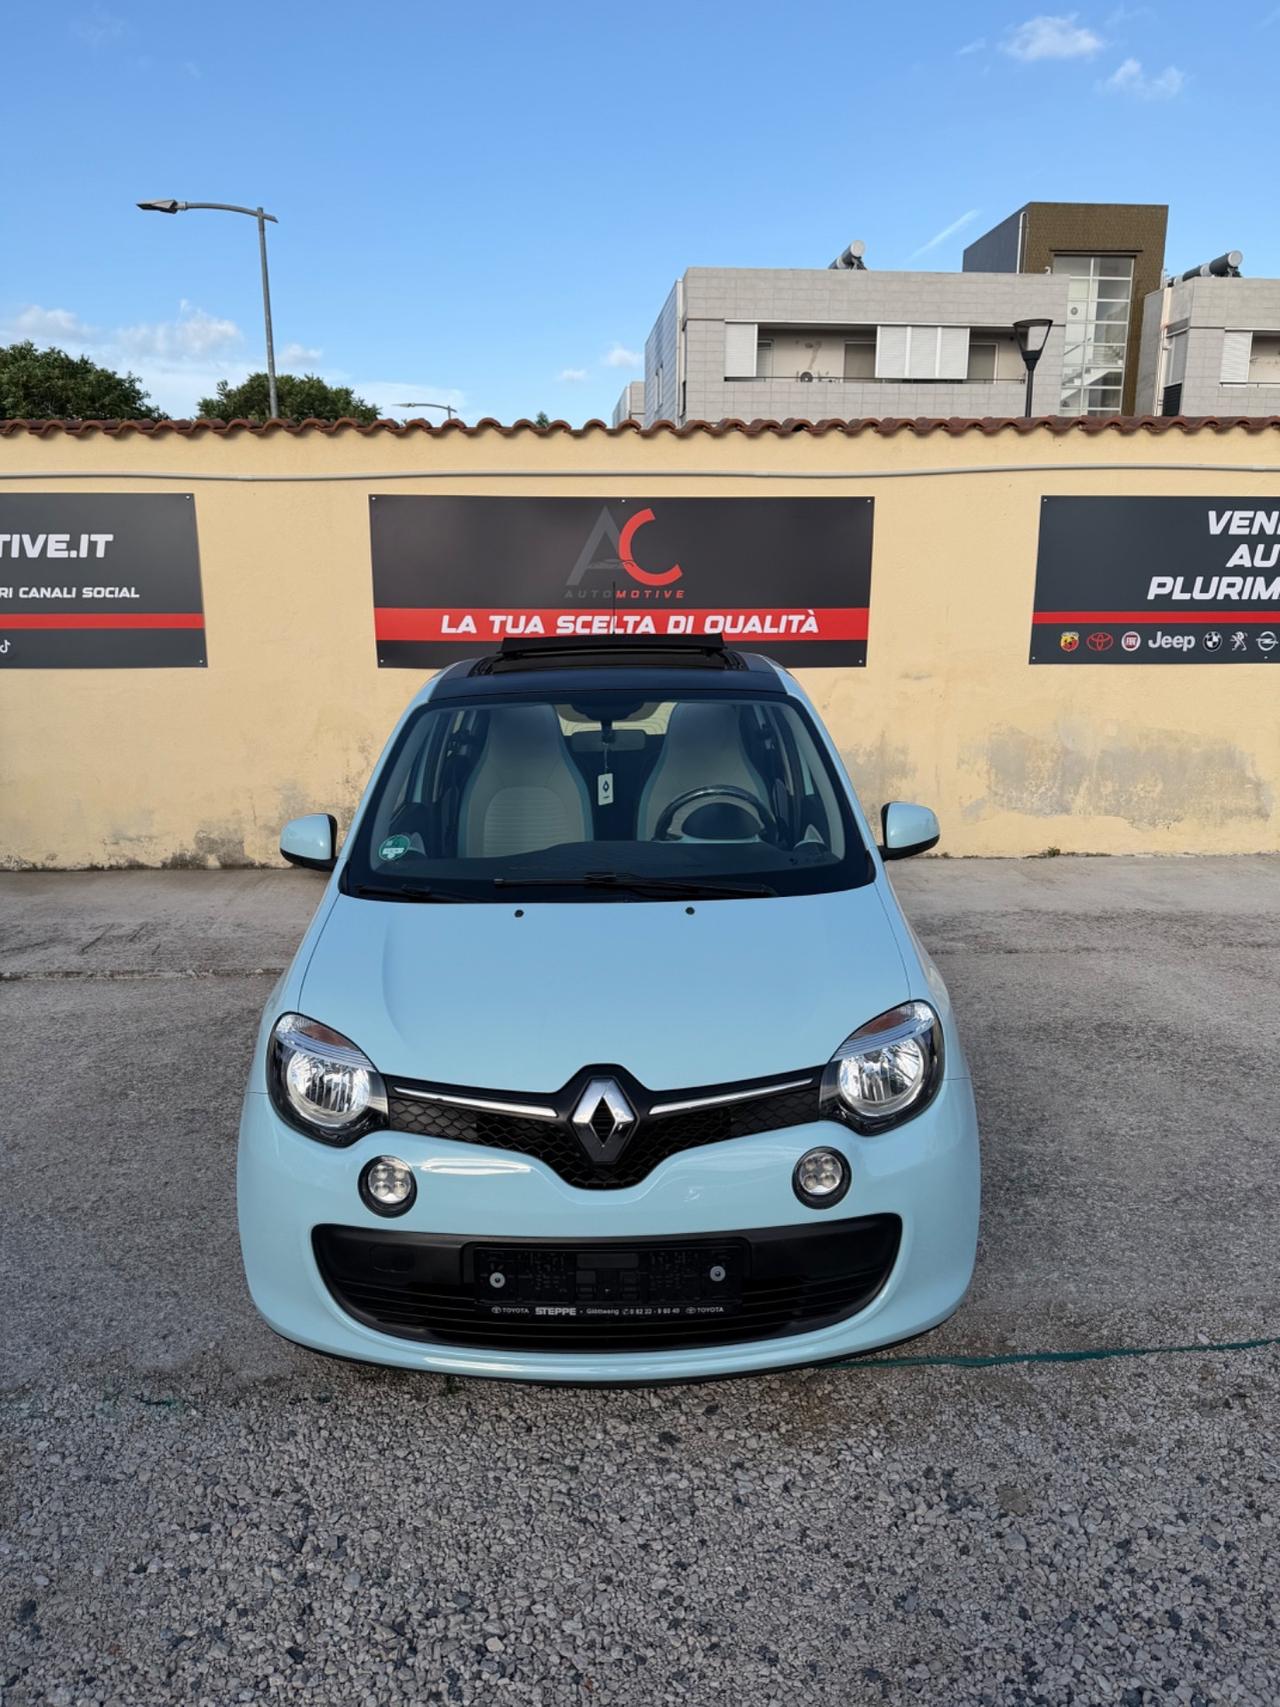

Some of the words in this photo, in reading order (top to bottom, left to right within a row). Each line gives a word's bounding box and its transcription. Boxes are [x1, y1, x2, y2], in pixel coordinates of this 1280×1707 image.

[1208, 510, 1280, 535] VEN
[18, 587, 76, 598] CANALI
[82, 587, 140, 598] SOCIAL
[564, 590, 686, 599] AUTOMOTIVE
[441, 615, 477, 634] LA
[489, 615, 544, 634] TUA
[556, 615, 656, 634] SCELTA
[667, 615, 694, 634] DI
[704, 609, 819, 634] QUALITÀ
[1148, 631, 1196, 651] Jeep
[535, 1307, 577, 1316] STEPPE
